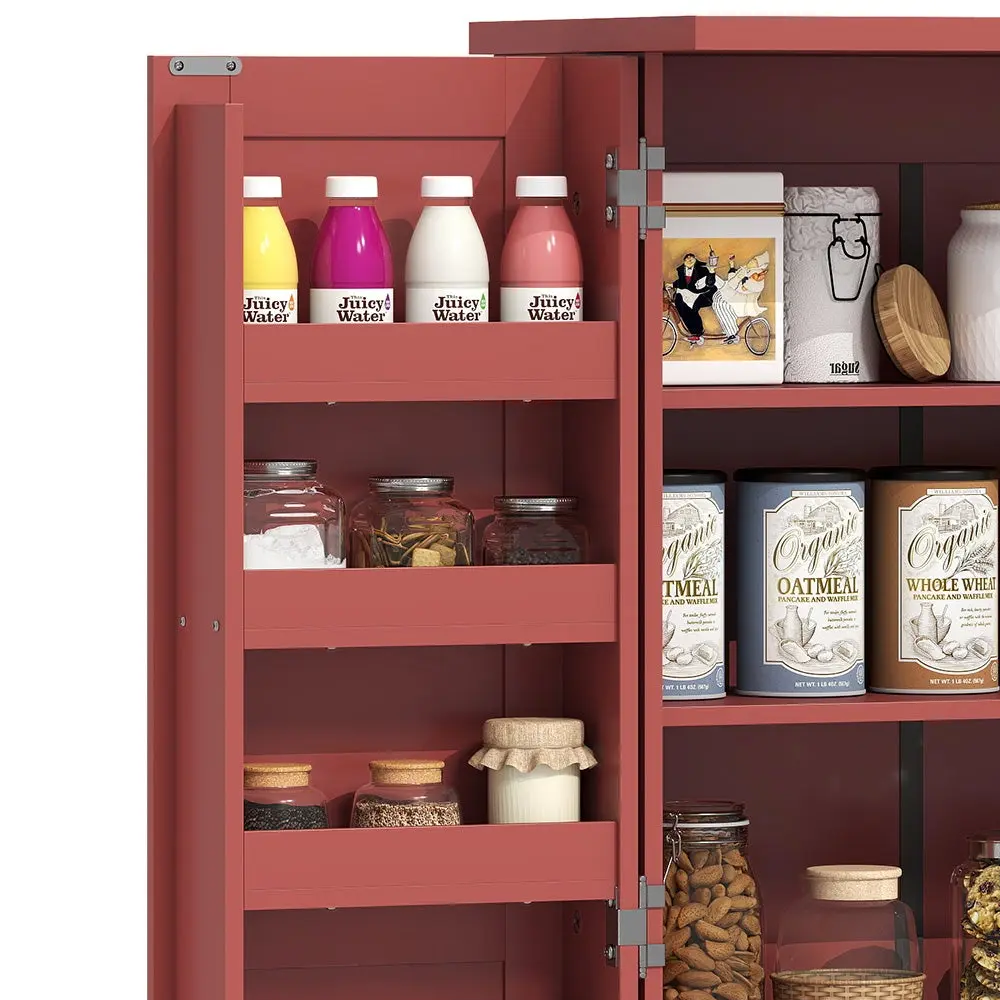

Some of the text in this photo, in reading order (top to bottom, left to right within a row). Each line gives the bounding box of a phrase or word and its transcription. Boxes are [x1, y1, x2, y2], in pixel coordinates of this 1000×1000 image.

[243, 297, 288, 313] Juicy
[338, 297, 384, 312] Juicy
[434, 296, 479, 311] Juicy
[529, 295, 575, 310] Juicy
[243, 311, 289, 322] Water
[337, 310, 386, 322] Water
[432, 309, 481, 321] Water
[527, 309, 576, 320] Water
[773, 512, 857, 575] Organic
[907, 510, 992, 574] Organic
[662, 579, 718, 598] TMEAL
[777, 576, 859, 595] OATMEAL
[905, 576, 996, 592] WHOLE WHEAT
